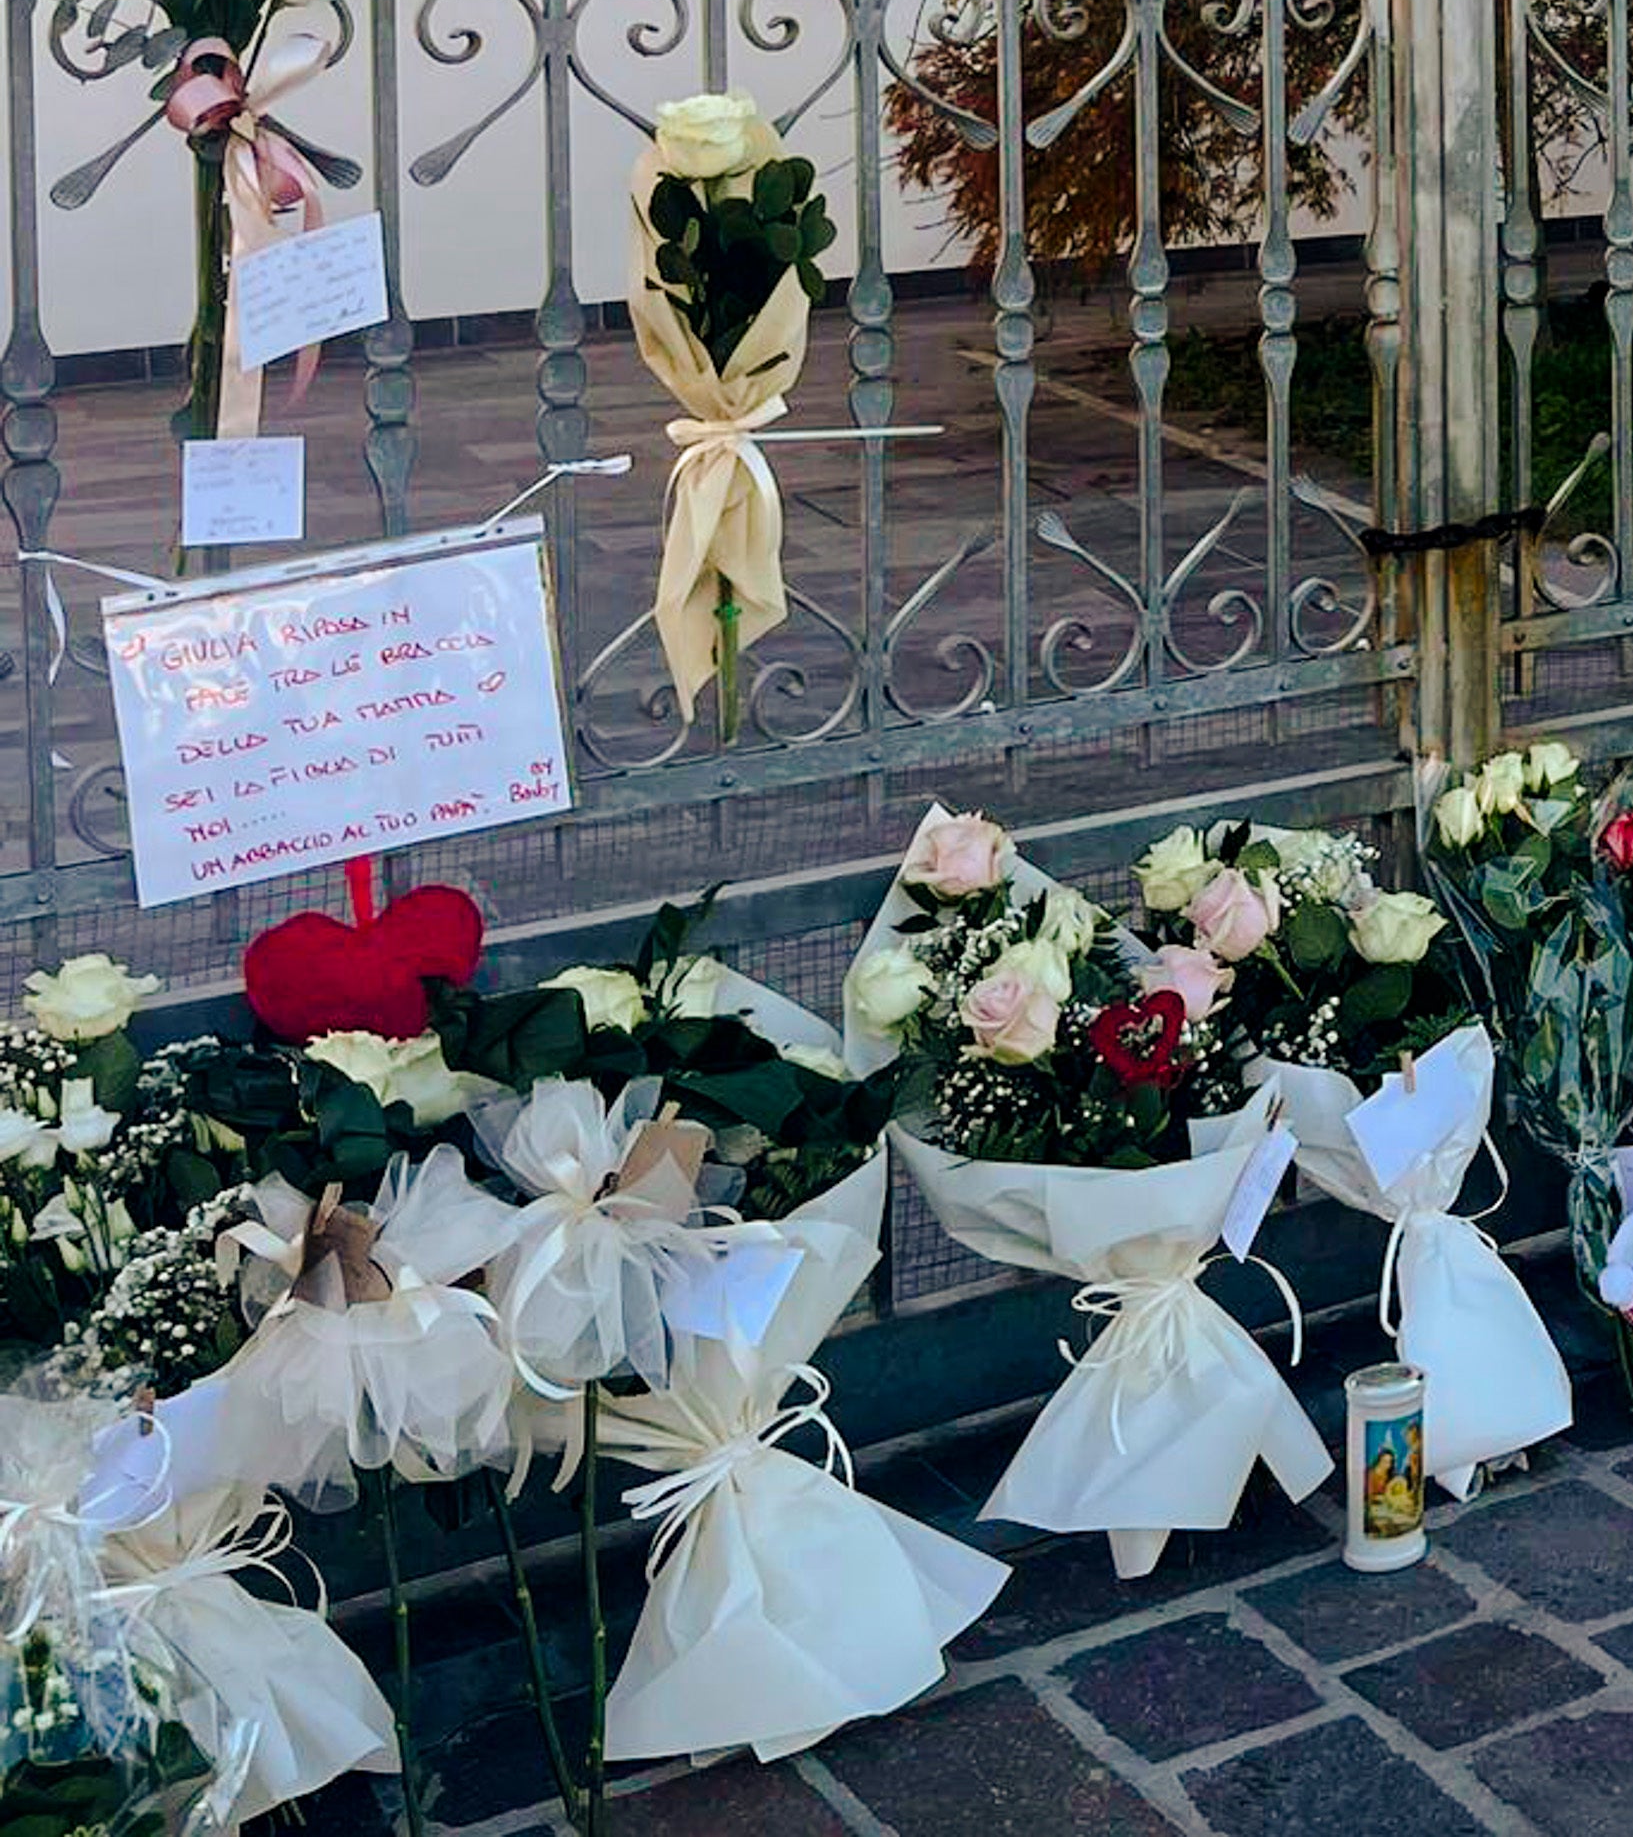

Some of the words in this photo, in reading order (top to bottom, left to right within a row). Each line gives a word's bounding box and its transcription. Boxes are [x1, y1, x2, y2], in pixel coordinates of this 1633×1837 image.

[161, 631, 258, 671] GIULIA
[280, 616, 370, 645] RIPOSA
[381, 605, 411, 625] IN
[268, 668, 321, 692] TRA
[332, 654, 361, 676] LE
[380, 634, 495, 664] BRACCIA
[176, 734, 269, 764] DELLA
[282, 710, 343, 734] TUA
[356, 689, 457, 719] MAMMA
[164, 786, 214, 813] SEI
[234, 781, 265, 797] LA
[367, 746, 395, 765] DI
[191, 857, 226, 881] UN
[341, 825, 370, 842] AL
[374, 813, 417, 833] TUO
